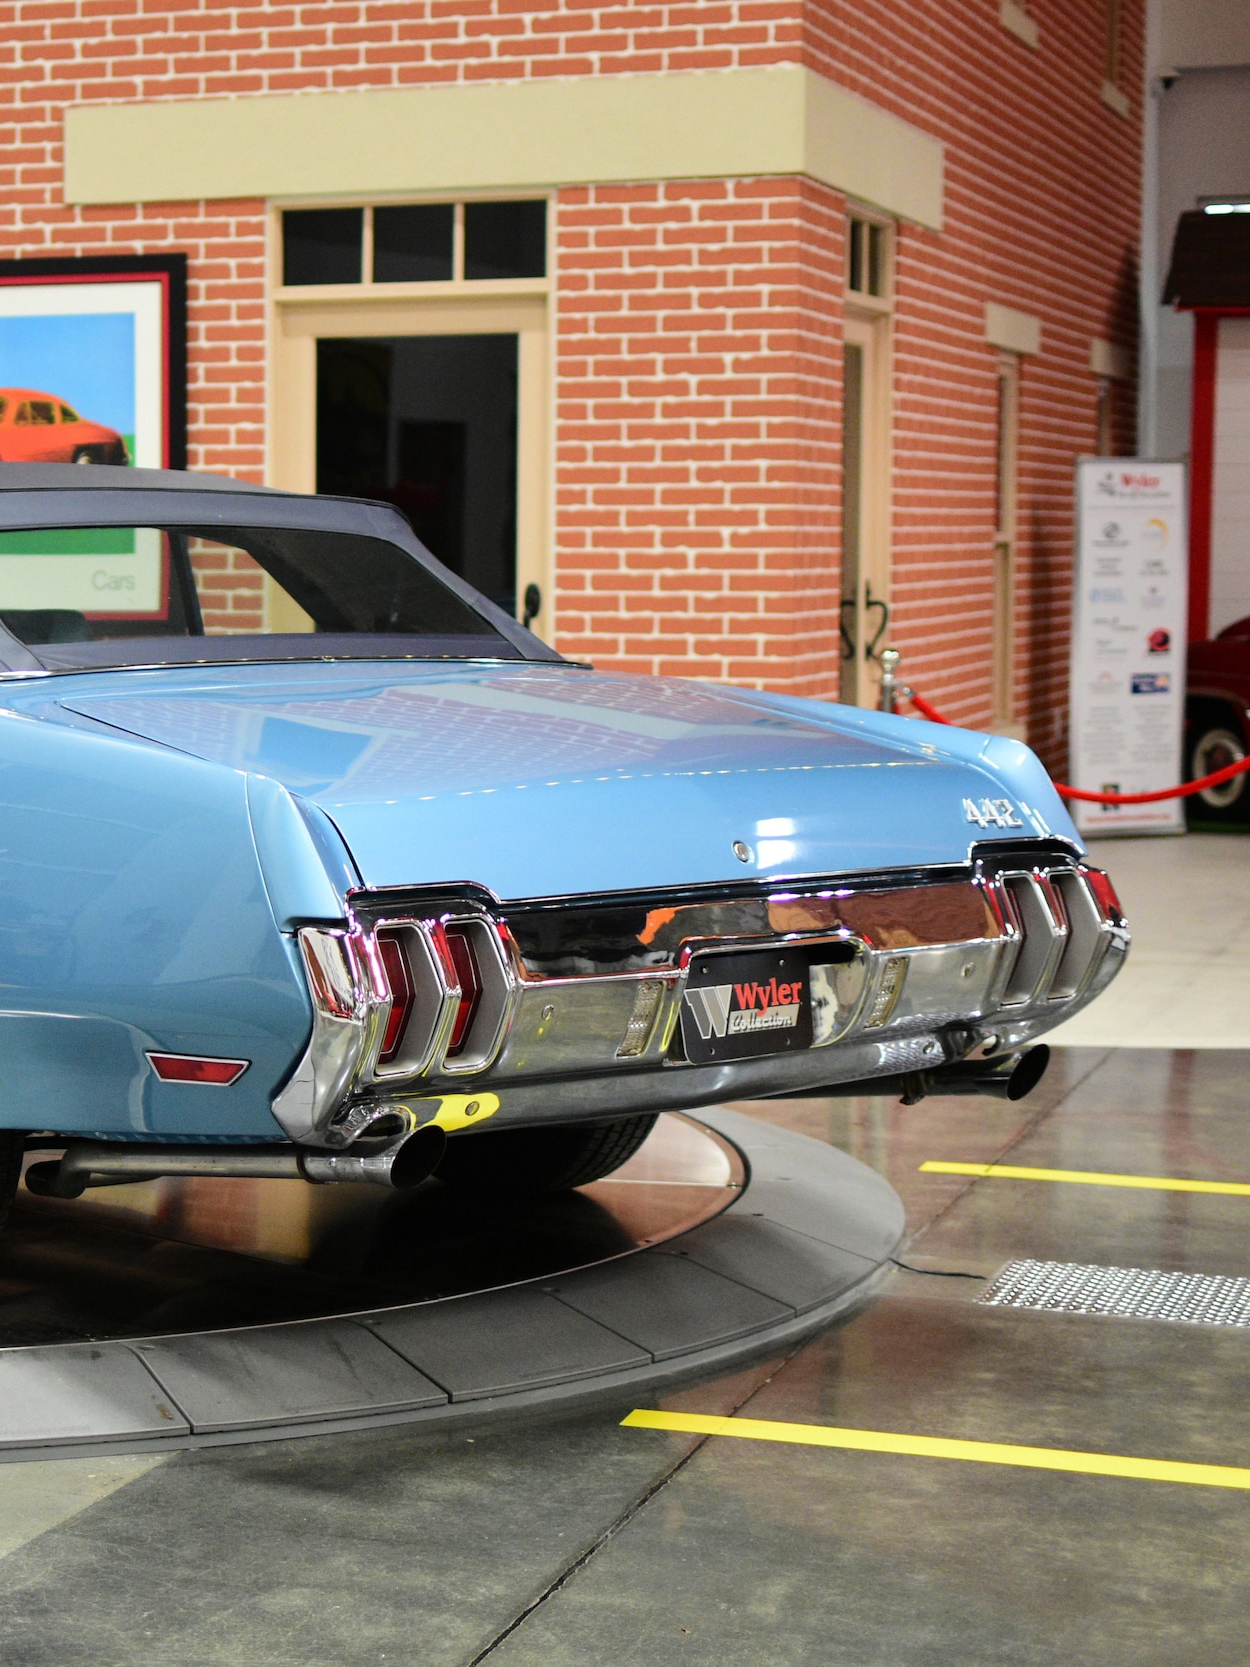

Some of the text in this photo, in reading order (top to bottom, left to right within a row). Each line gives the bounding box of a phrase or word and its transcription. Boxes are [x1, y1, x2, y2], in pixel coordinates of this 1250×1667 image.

[91, 569, 136, 590] Cars
[962, 798, 1023, 828] 442
[734, 977, 802, 1016] Wyler
[731, 1012, 792, 1032] Collection
